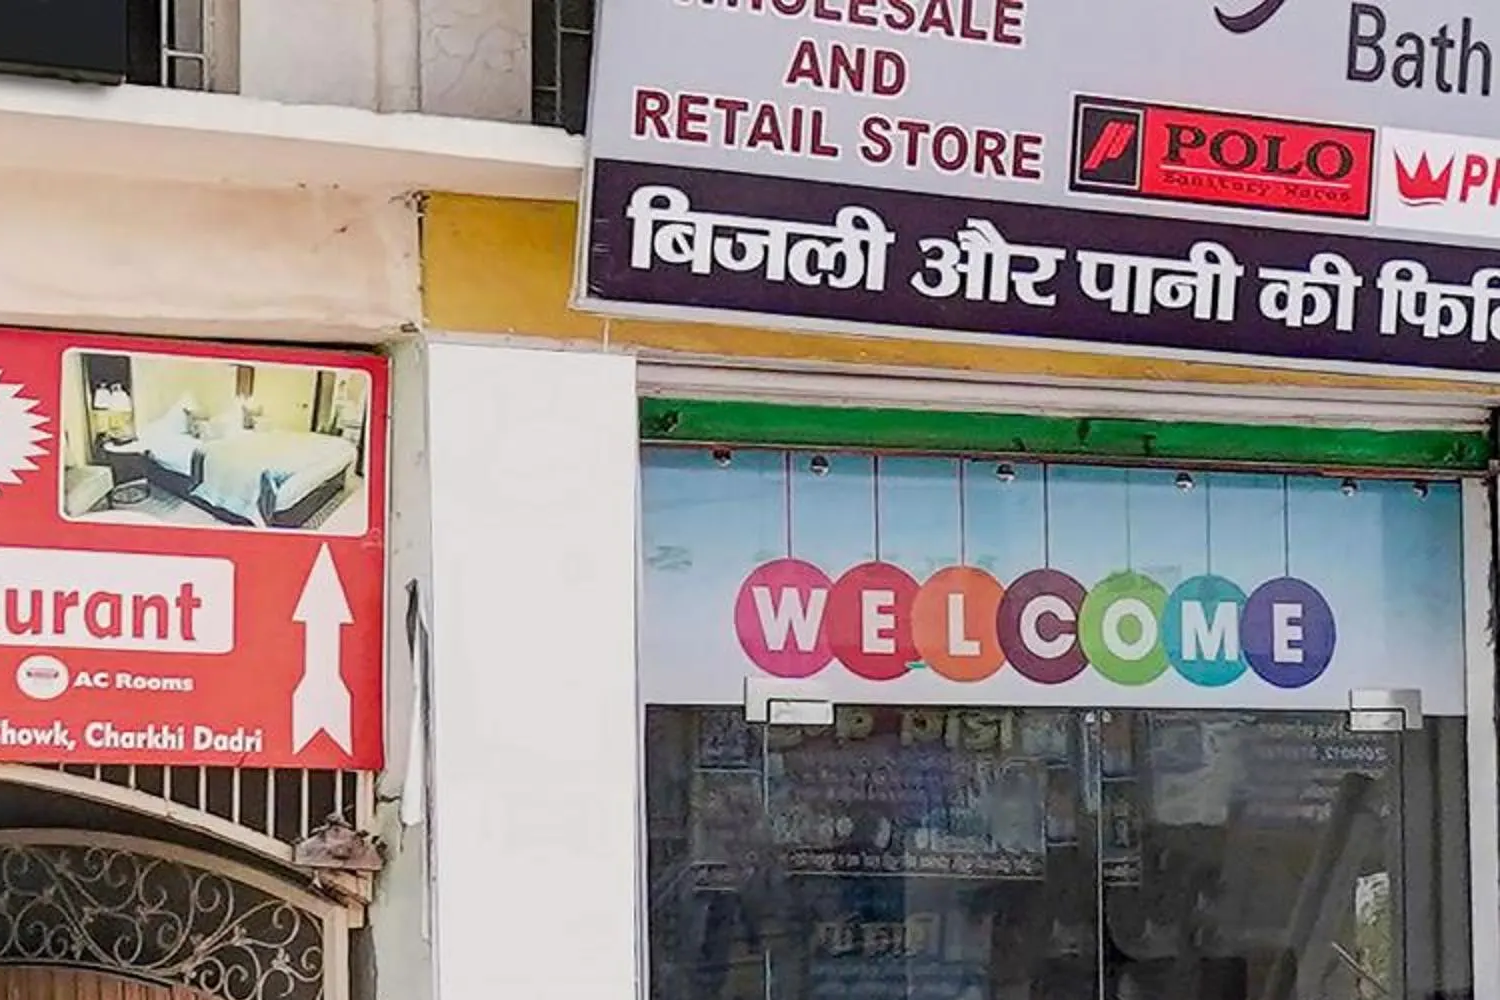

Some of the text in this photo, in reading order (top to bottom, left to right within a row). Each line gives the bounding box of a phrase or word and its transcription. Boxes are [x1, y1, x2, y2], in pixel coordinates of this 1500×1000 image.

[786, 40, 907, 96] AND
[1346, 3, 1493, 97] Bath
[633, 88, 1043, 181] RETAIL STORE
[1163, 122, 1354, 181] POLO
[627, 185, 895, 292] बिजली
[911, 217, 1065, 308] और
[1077, 240, 1244, 322] पानी
[1259, 253, 1364, 333] की
[752, 586, 1304, 665] WELCOME
[71, 671, 194, 693] AC Rooms
[83, 721, 187, 752] Charkhi
[191, 725, 263, 754] Dadri
